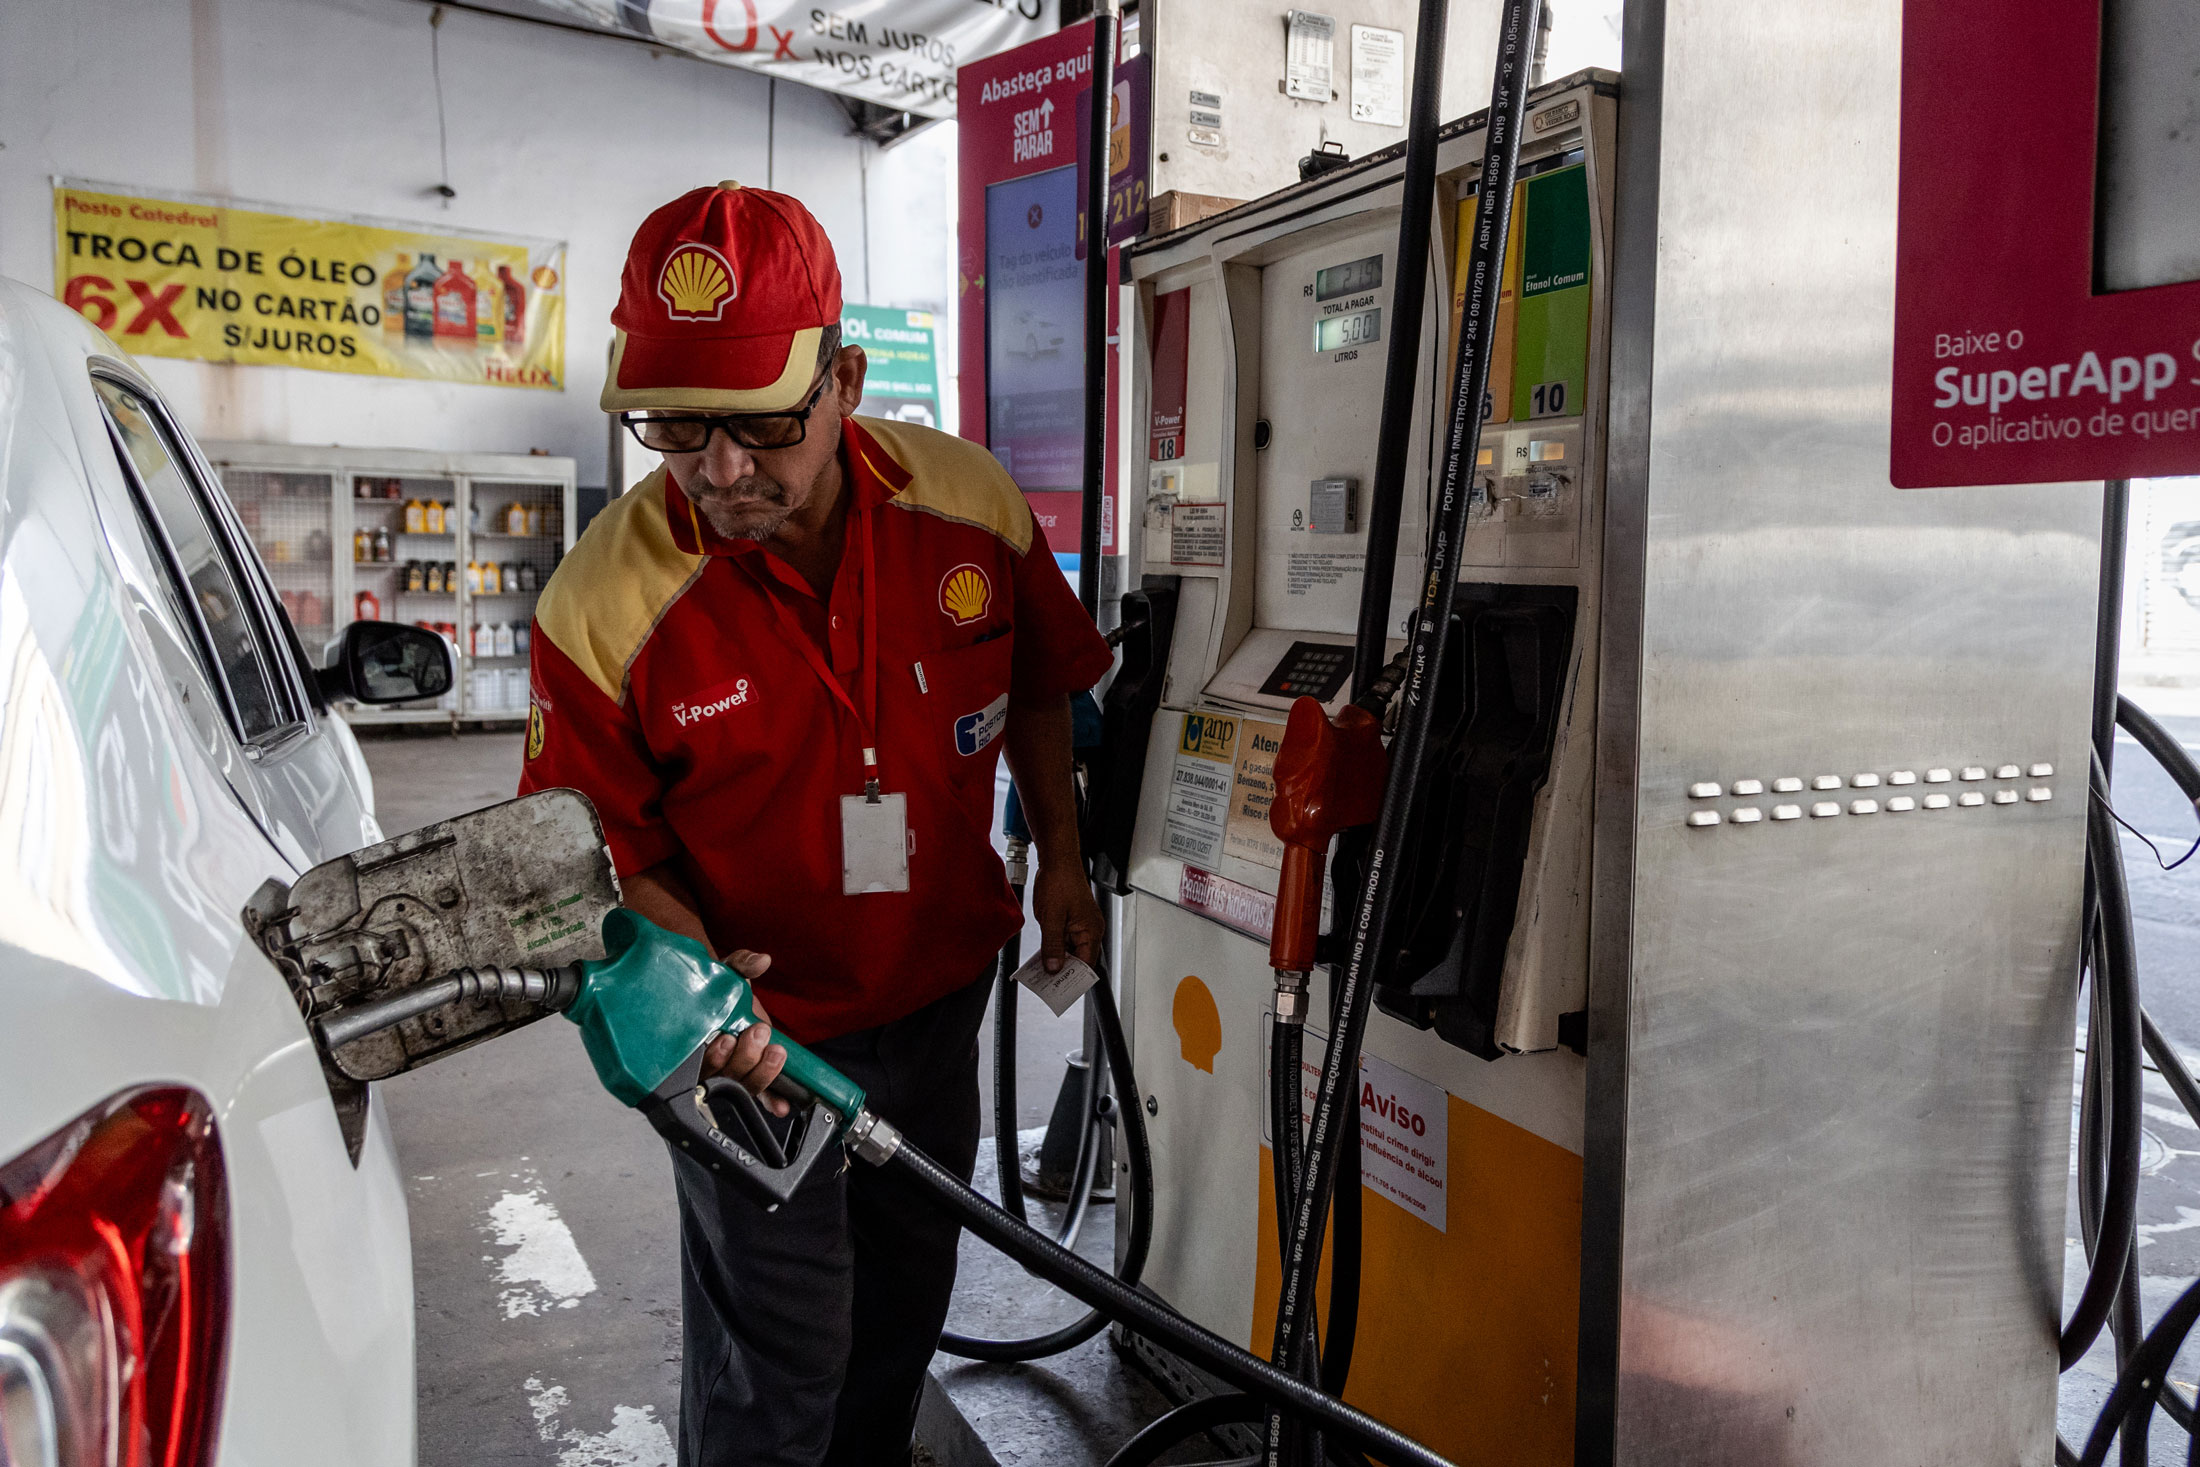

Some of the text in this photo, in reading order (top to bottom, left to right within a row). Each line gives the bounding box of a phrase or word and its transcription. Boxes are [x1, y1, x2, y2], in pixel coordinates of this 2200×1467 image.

[810, 9, 956, 67] SEM JUROS
[813, 48, 871, 80] NOS
[981, 46, 1092, 105] Abasteça aqui
[1013, 107, 1040, 138] SEM
[1494, 115, 1506, 144] DN19
[1013, 129, 1054, 163] PARAR
[64, 196, 218, 228] Posto Catedral
[1112, 180, 1146, 225] 212
[1479, 154, 1501, 250] ABNT NBR 15690
[66, 231, 376, 287] TROCA DE ÓLEO
[1303, 284, 1314, 298] R$
[1470, 261, 1487, 318] 08/11/2019
[1526, 271, 1585, 292] Etanol Comum
[196, 287, 381, 326] NO CARTÃO
[1323, 295, 1375, 316] TOTAL A PAGAR
[223, 325, 357, 357] S/JUROS
[1467, 319, 1479, 341] 245
[1934, 329, 2024, 359] Baixe o
[1334, 350, 1358, 363] LITROS
[1934, 351, 2178, 414] SuperApp
[1451, 359, 1473, 450] INMETRO/DIMEL
[1534, 383, 1565, 415] 10
[1154, 415, 1181, 427] V-Power
[1932, 422, 1953, 448] O
[1958, 414, 2081, 450] aplicativo
[2088, 408, 2124, 437] de
[1159, 438, 1174, 459] 18
[1516, 447, 1528, 458] R$
[1443, 453, 1460, 512] PORTARIA
[672, 702, 686, 713] Shell
[673, 689, 748, 727] V-Power
[978, 707, 1007, 736] POSTOS
[978, 733, 991, 748] RIO
[1204, 717, 1234, 750] anp
[1251, 733, 1280, 754] Aten
[1242, 759, 1248, 771] A
[1237, 772, 1268, 792] Benzeno,
[1242, 804, 1262, 820] Risco
[1180, 877, 1227, 912] PRODUTOS
[1226, 892, 1266, 929] NOCIVOS
[1326, 848, 1385, 1095] REQUERENTE HLEMMAN IND E COM PROD IND
[1288, 1038, 1299, 1112] INMETRO/DIMEL
[1289, 1114, 1298, 1128] 137
[1361, 1082, 1426, 1137] Aviso
[1290, 1132, 1298, 1147] DE
[1386, 1135, 1409, 1153] crime
[1411, 1147, 1436, 1168] dirigir
[1366, 1138, 1404, 1168] influência
[1405, 1161, 1415, 1174] de
[1417, 1167, 1443, 1190] álcool
[1292, 1245, 1304, 1263] WP
[1298, 1197, 1312, 1242] 10,5MPa
[1306, 1150, 1321, 1192] 1520PSI
[1315, 1102, 1331, 1145] 105BAR
[1269, 1414, 1281, 1449] 15690
